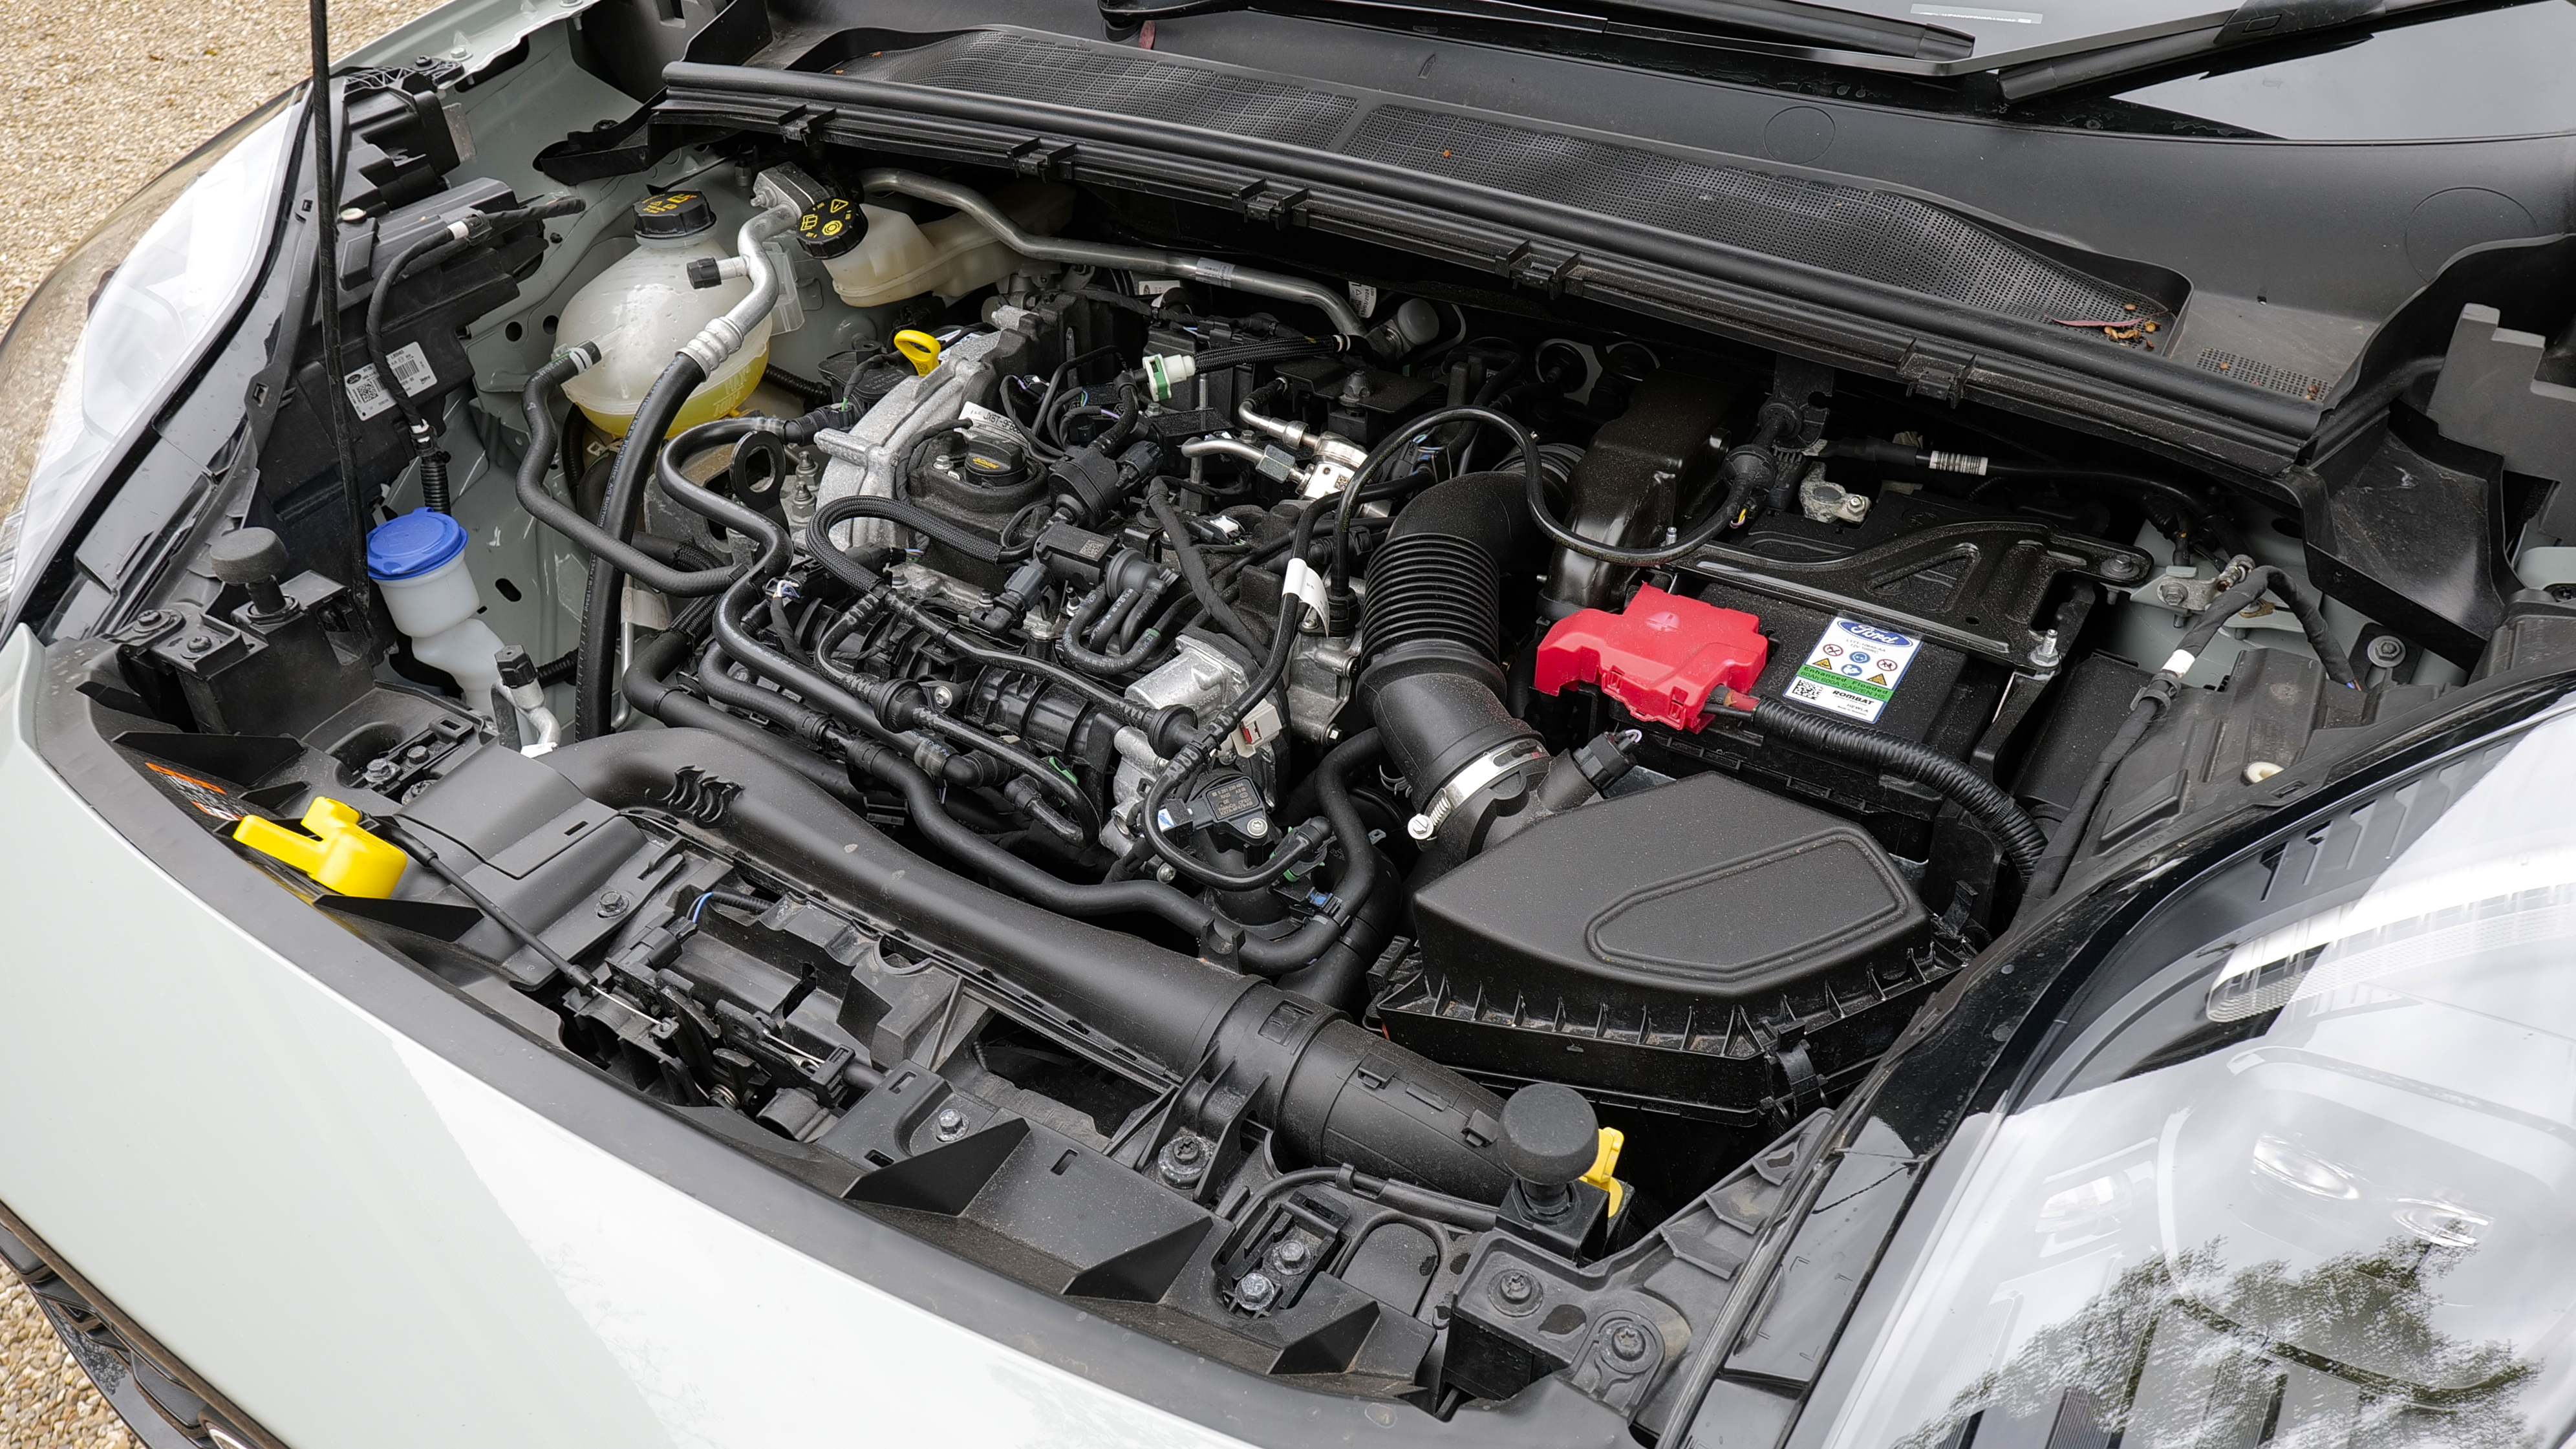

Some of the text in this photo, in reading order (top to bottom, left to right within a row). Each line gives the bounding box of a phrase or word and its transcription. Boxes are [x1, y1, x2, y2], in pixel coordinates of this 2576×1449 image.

[599, 496, 611, 527] SUCTION
[1851, 625, 1899, 645] Ford
[1801, 671, 1819, 681] 60Ah
[1821, 678, 1840, 687] 600A
[1841, 682, 1873, 696] SAE/EN
[1803, 667, 1889, 694] Enhanced Flooded
[1832, 690, 1874, 705] ROMBAT
